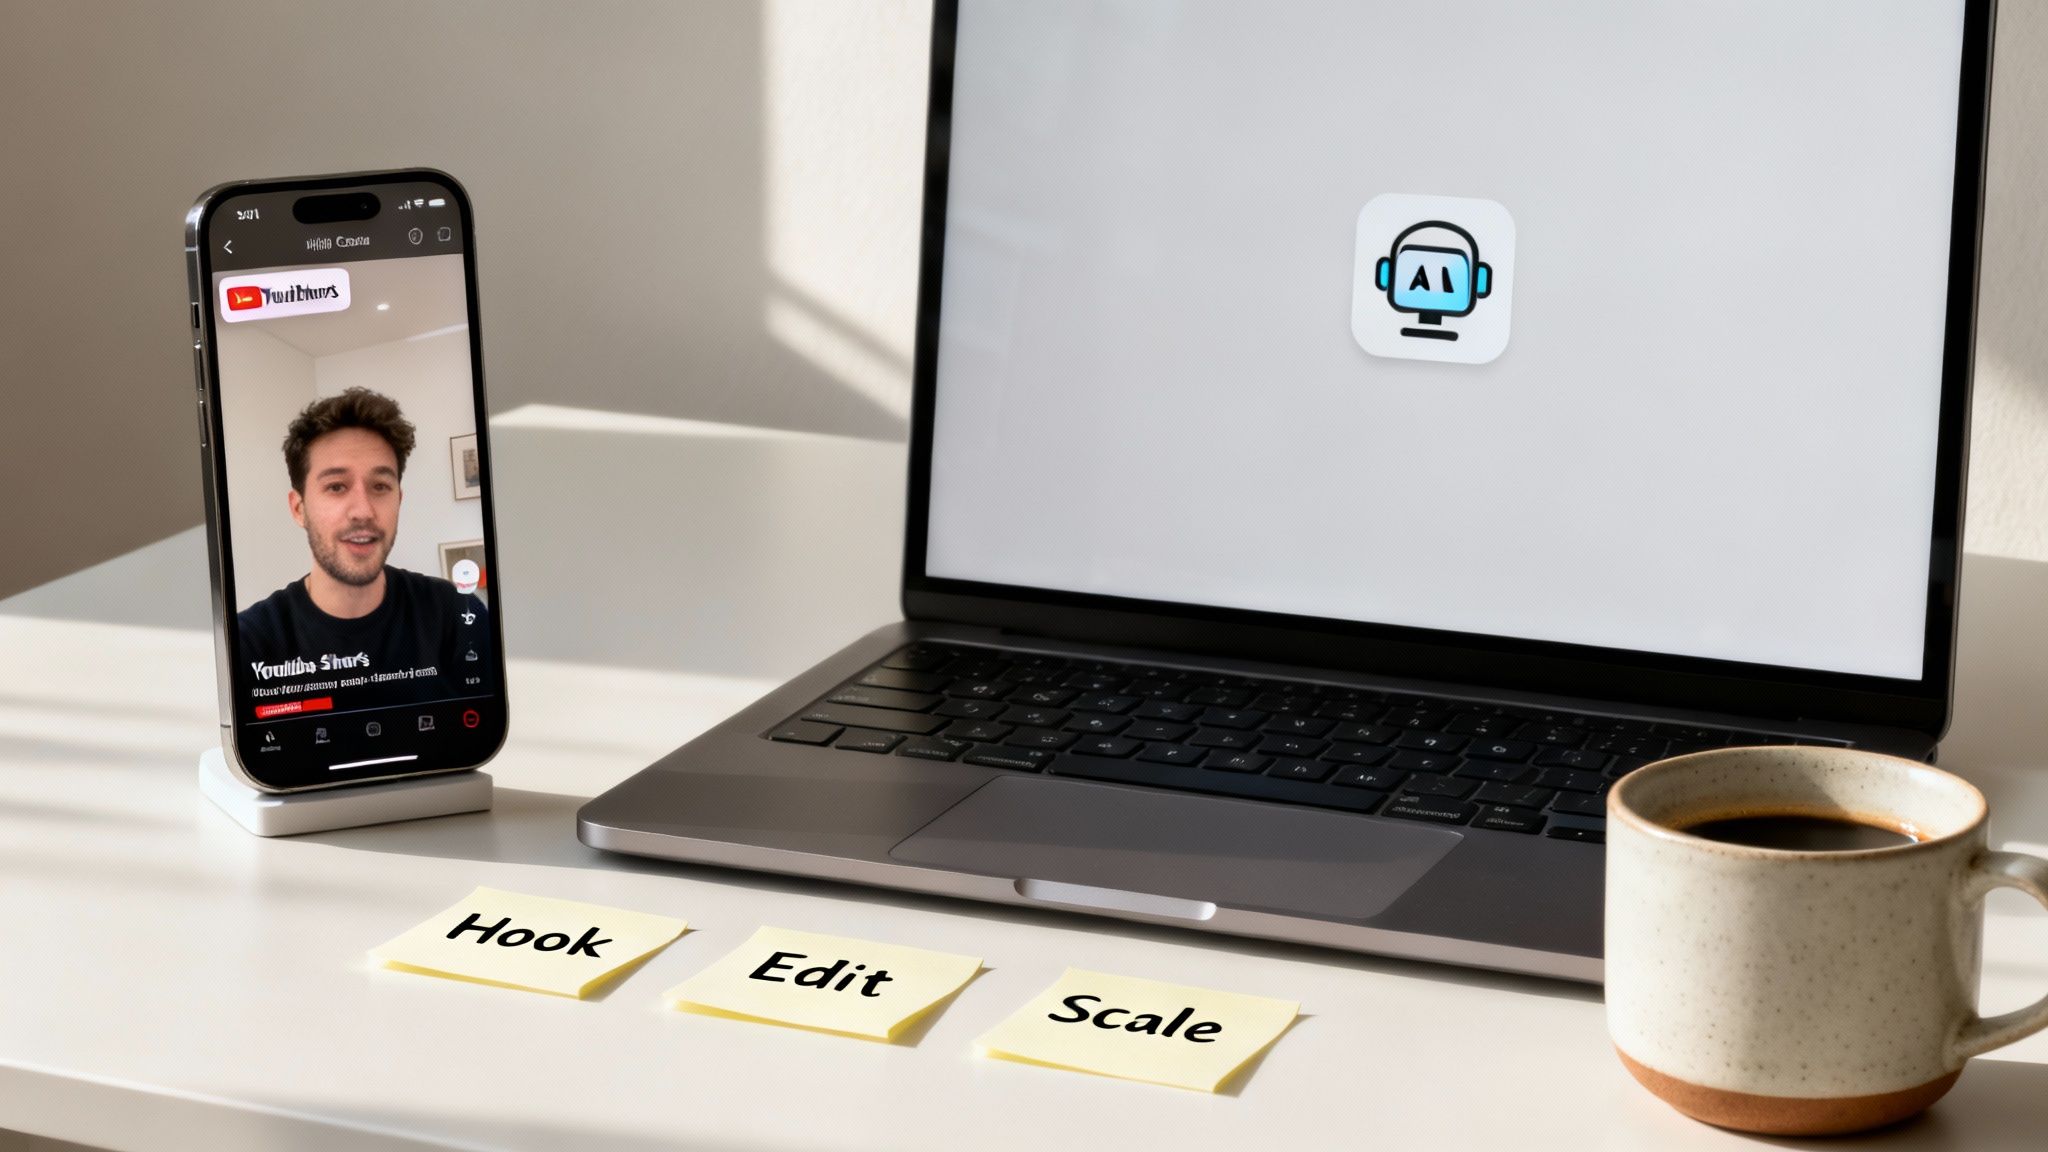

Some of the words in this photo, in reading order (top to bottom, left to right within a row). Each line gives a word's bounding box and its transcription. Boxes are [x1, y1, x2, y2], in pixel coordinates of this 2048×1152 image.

[446, 913, 613, 959] Hook
[748, 951, 894, 999] Edit
[1047, 994, 1224, 1044] Scale
